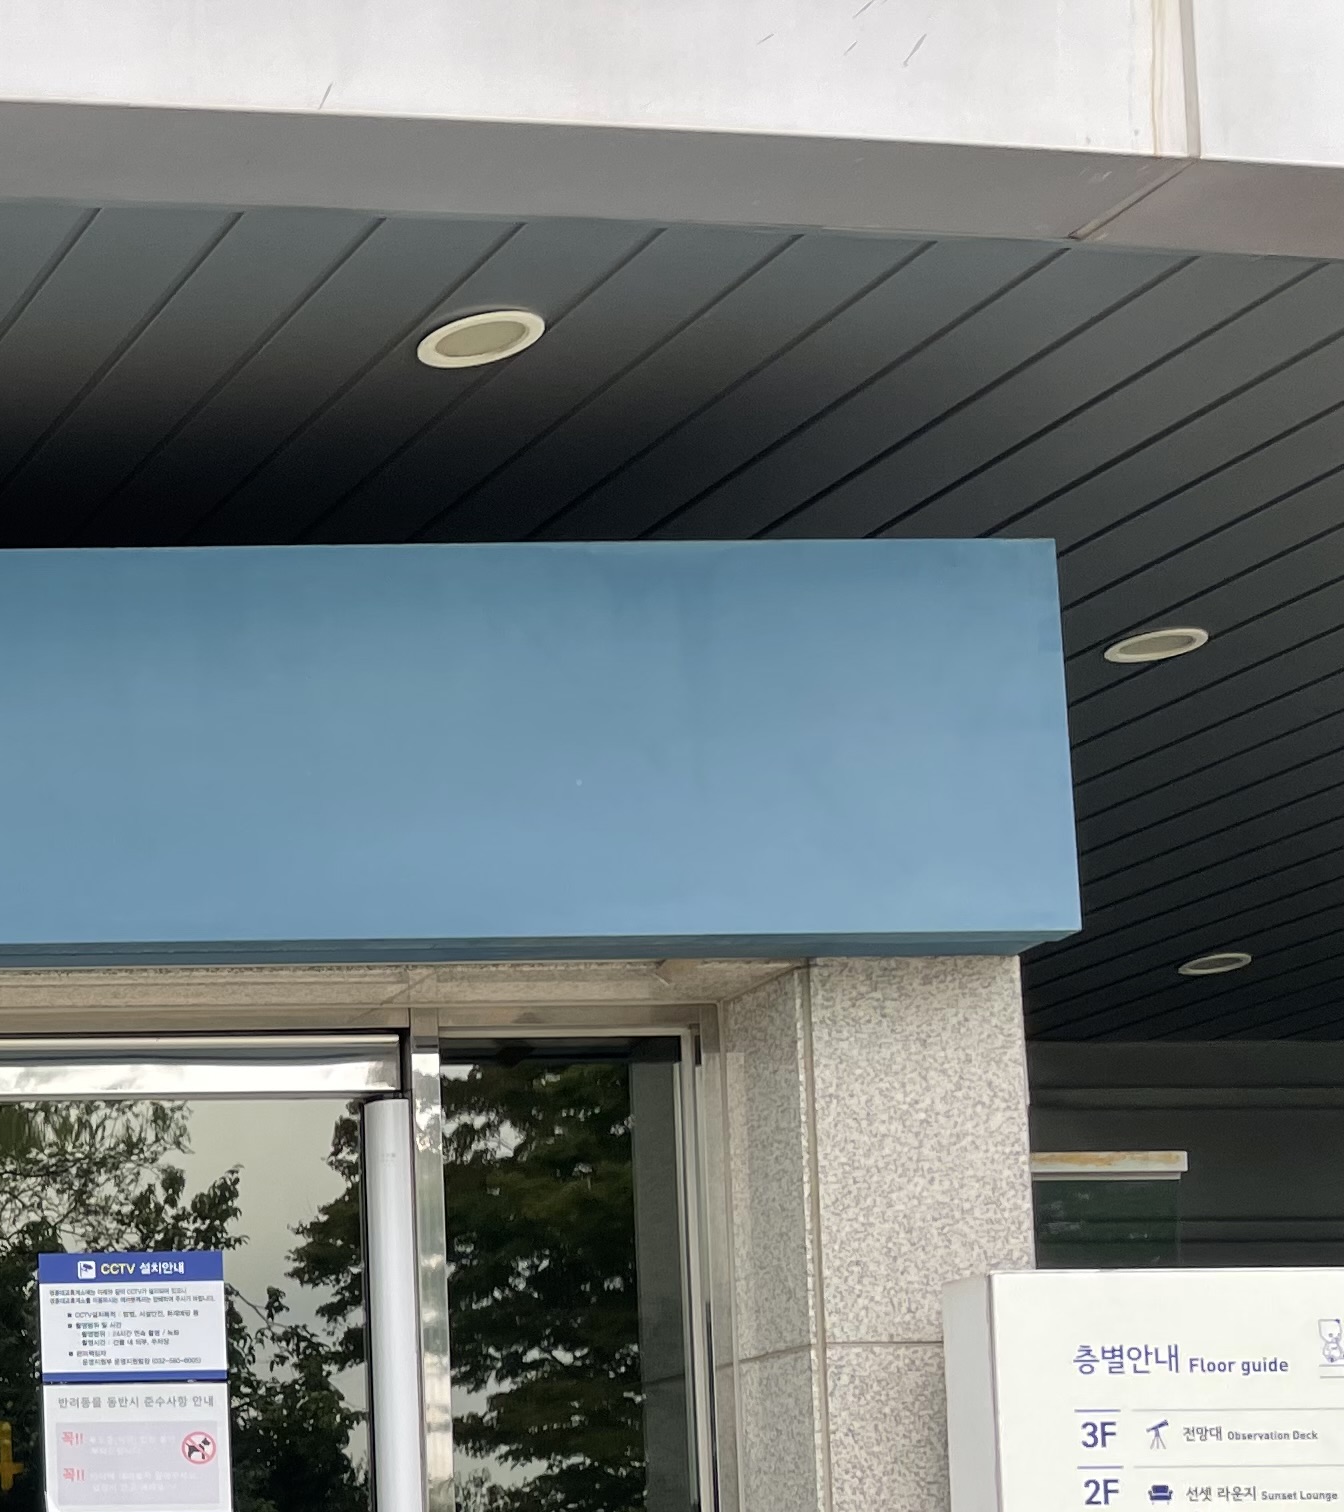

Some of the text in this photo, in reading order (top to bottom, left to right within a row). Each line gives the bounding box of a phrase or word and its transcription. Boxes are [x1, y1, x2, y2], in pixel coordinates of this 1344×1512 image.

[100, 1261, 185, 1275] CCTV 설치안내
[1073, 1344, 1289, 1376] 층별안내 Floor guide
[57, 1395, 214, 1409] 반려동물 동반시 준수사항 안내
[1081, 1422, 1318, 1448] 3F 전망대 Observation Deck
[1084, 1479, 1339, 1506] 2F 선셋 라운지 Sunset Lounge
